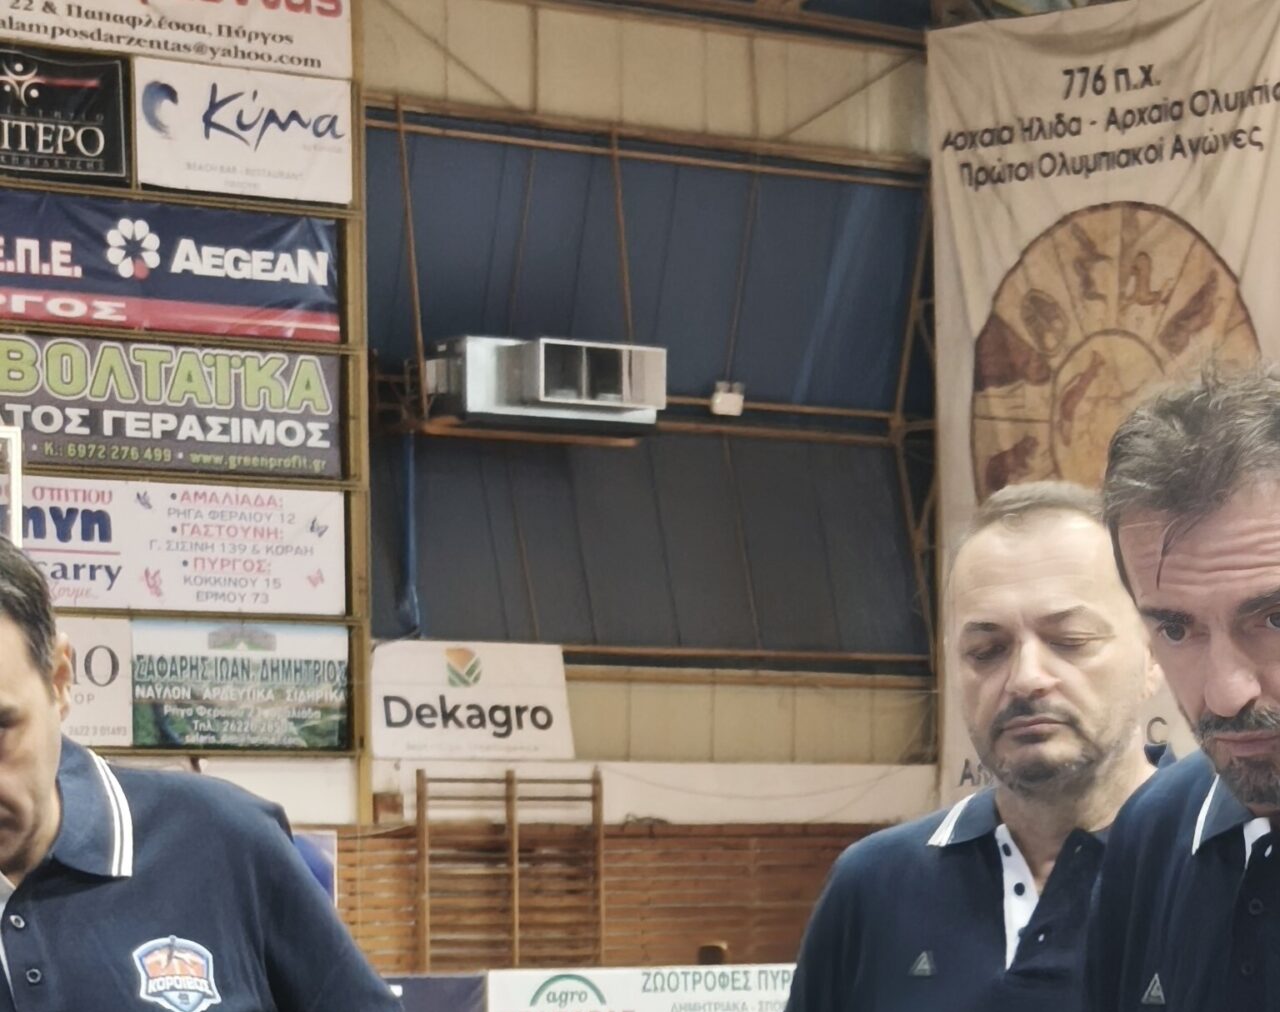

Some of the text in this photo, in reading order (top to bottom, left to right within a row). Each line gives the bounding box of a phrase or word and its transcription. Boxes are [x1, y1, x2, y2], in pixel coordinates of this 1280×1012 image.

[1062, 64, 1107, 100] 776
[103, 410, 331, 449] ΓΕΡΑΣΙΜΟΣ
[67, 443, 106, 459] 6972
[180, 490, 284, 510] ΑΜΑΛΙΑΔΑ:
[167, 507, 296, 526] ΡΗΓΑ ΦΕΡΑΙΟΥ 12
[180, 523, 284, 541] ΓΑΣΤΟΥΝΗ:
[219, 541, 248, 555] 139
[265, 543, 314, 557] ΚΟΡΑΗ
[193, 557, 272, 575] ΠΥΡΓΟΣ:
[183, 575, 282, 590] ΚΟΚΚΙΝΟΥ 15
[196, 590, 270, 606] ΕΡΜΟΥ 73
[135, 654, 209, 681] ΣΑΦΑΡΗΣ
[383, 694, 553, 739] Dekagro
[642, 970, 753, 994] ΖΩΟΤΡΟΦΕΣ
[546, 989, 588, 1008] agro
